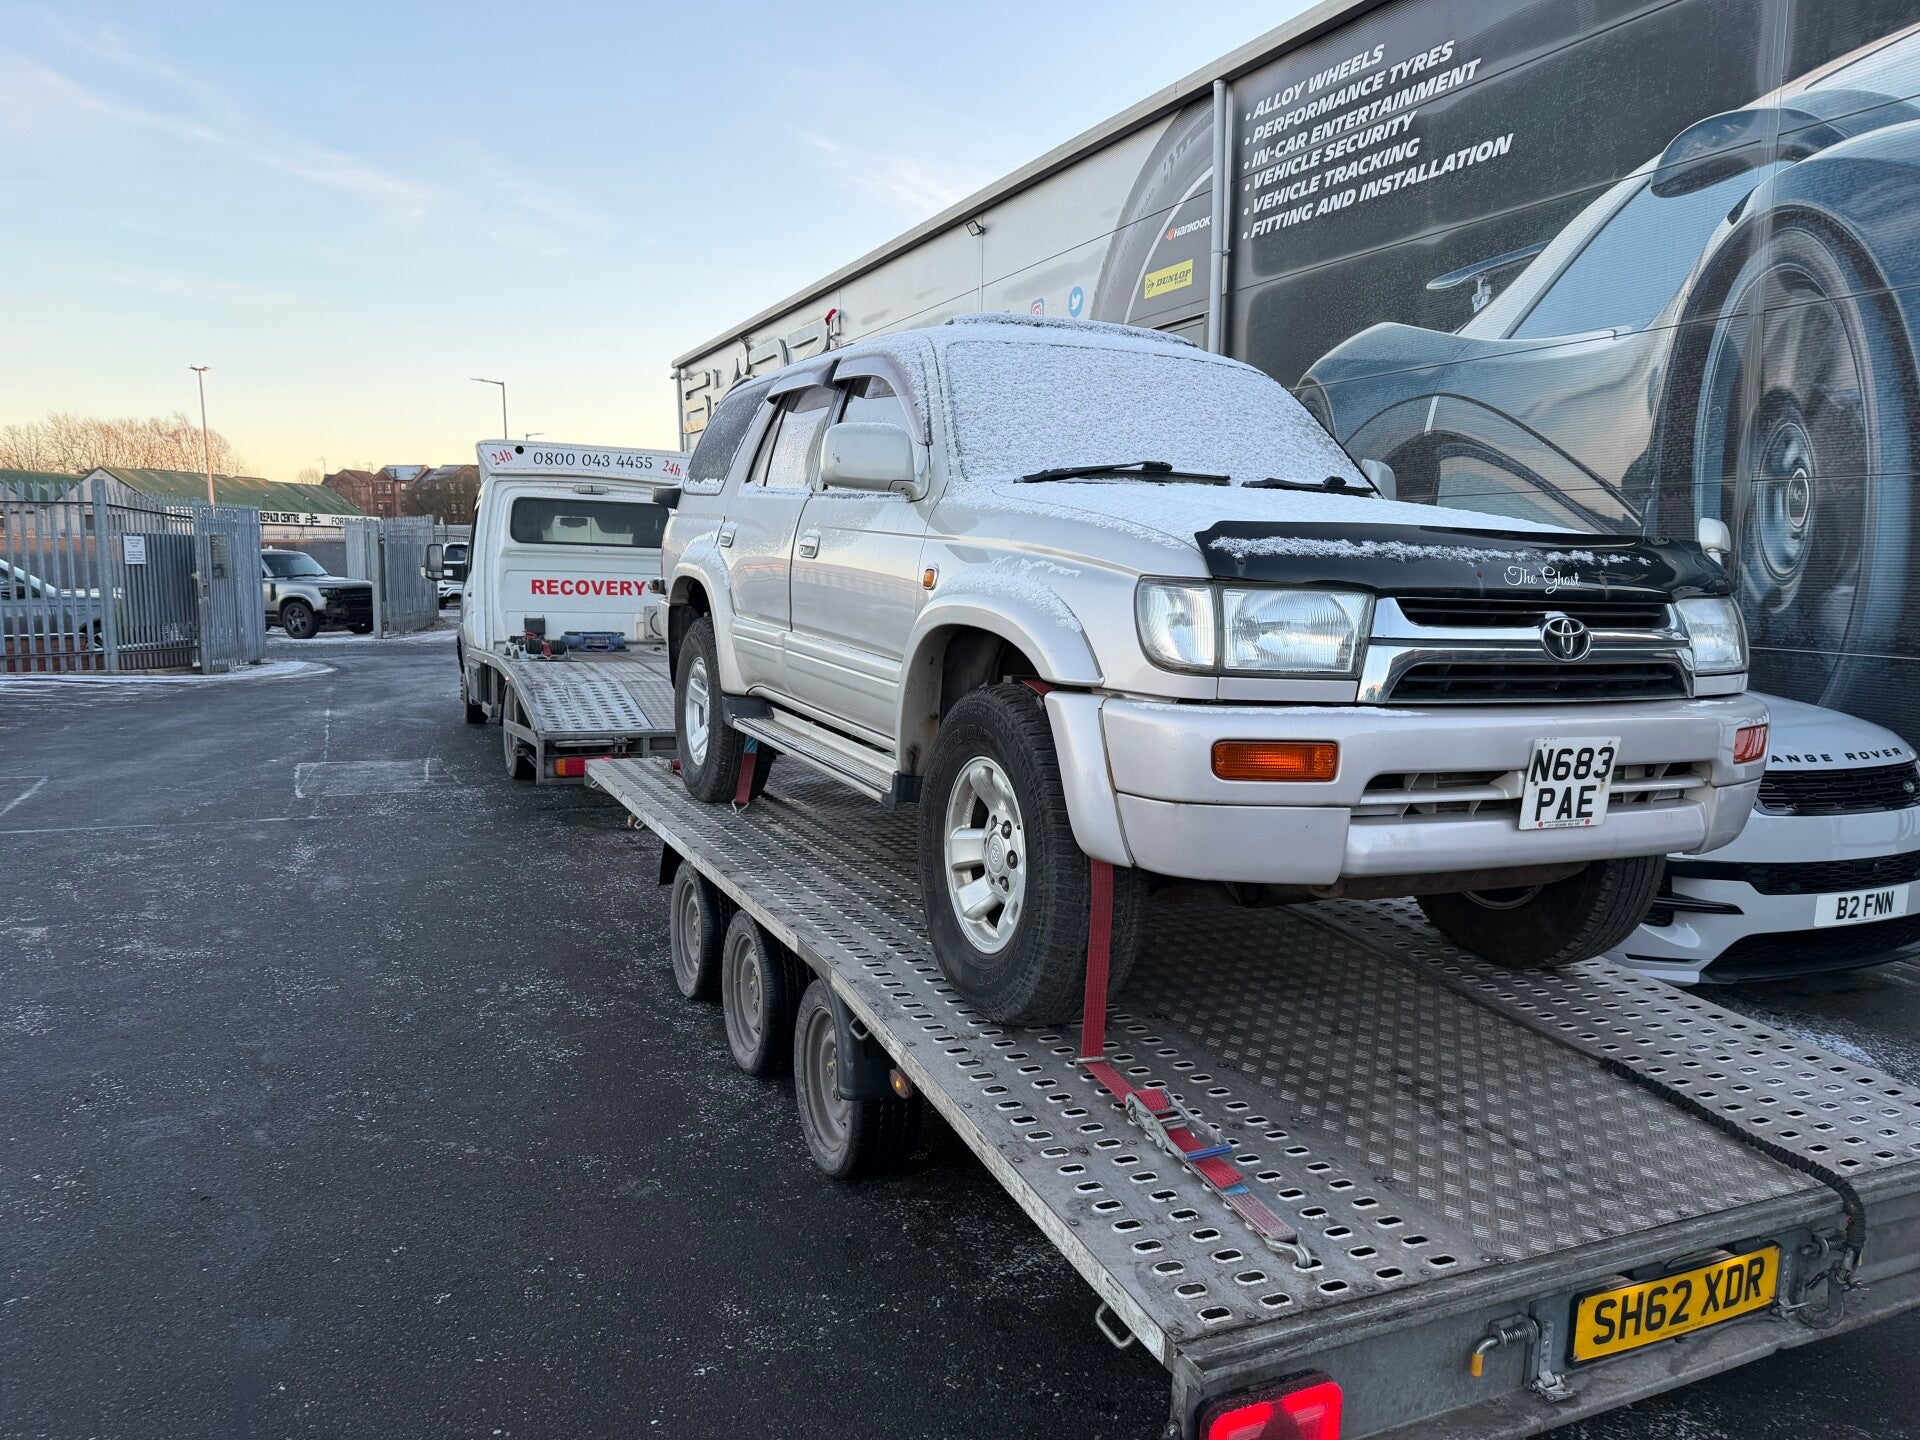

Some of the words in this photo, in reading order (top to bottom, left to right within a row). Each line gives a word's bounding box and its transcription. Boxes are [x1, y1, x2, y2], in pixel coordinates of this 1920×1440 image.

[1252, 81, 1305, 119] ALLOY
[1308, 44, 1386, 94] WHEELS
[1252, 76, 1384, 144] PERFORMANCE
[1389, 40, 1455, 80] TYRES
[1251, 132, 1308, 169] IN-CAR
[1311, 58, 1482, 142] ENTERTAINMENT
[1254, 149, 1321, 190] VEHICLE
[1325, 111, 1418, 160] SECURITY
[1250, 203, 1313, 239] FITTING
[1315, 188, 1357, 217] AND
[1358, 133, 1514, 202] INSTALLATION
[1252, 175, 1321, 215] VEHICLE
[1324, 138, 1421, 187] TRACKING
[1156, 268, 1192, 287] DUNLOP
[490, 449, 513, 466] 24h
[533, 452, 576, 466] 0800
[582, 453, 610, 468] 043
[616, 454, 653, 469] 4455
[662, 459, 682, 476] 24h
[260, 511, 279, 522] REPAIR
[280, 513, 300, 524] CENTRE
[531, 579, 647, 596] RECOVERY
[1503, 565, 1537, 586] The
[1538, 565, 1581, 595] Ghost
[1529, 746, 1615, 783] N683
[1770, 753, 1833, 763] ANGE
[1844, 747, 1902, 760] ROVER
[1534, 785, 1598, 822] PAE
[1835, 896, 1861, 920] B2
[1863, 890, 1895, 917] FNN
[1592, 1279, 1693, 1345] SH62
[1700, 1256, 1765, 1317] XDR
